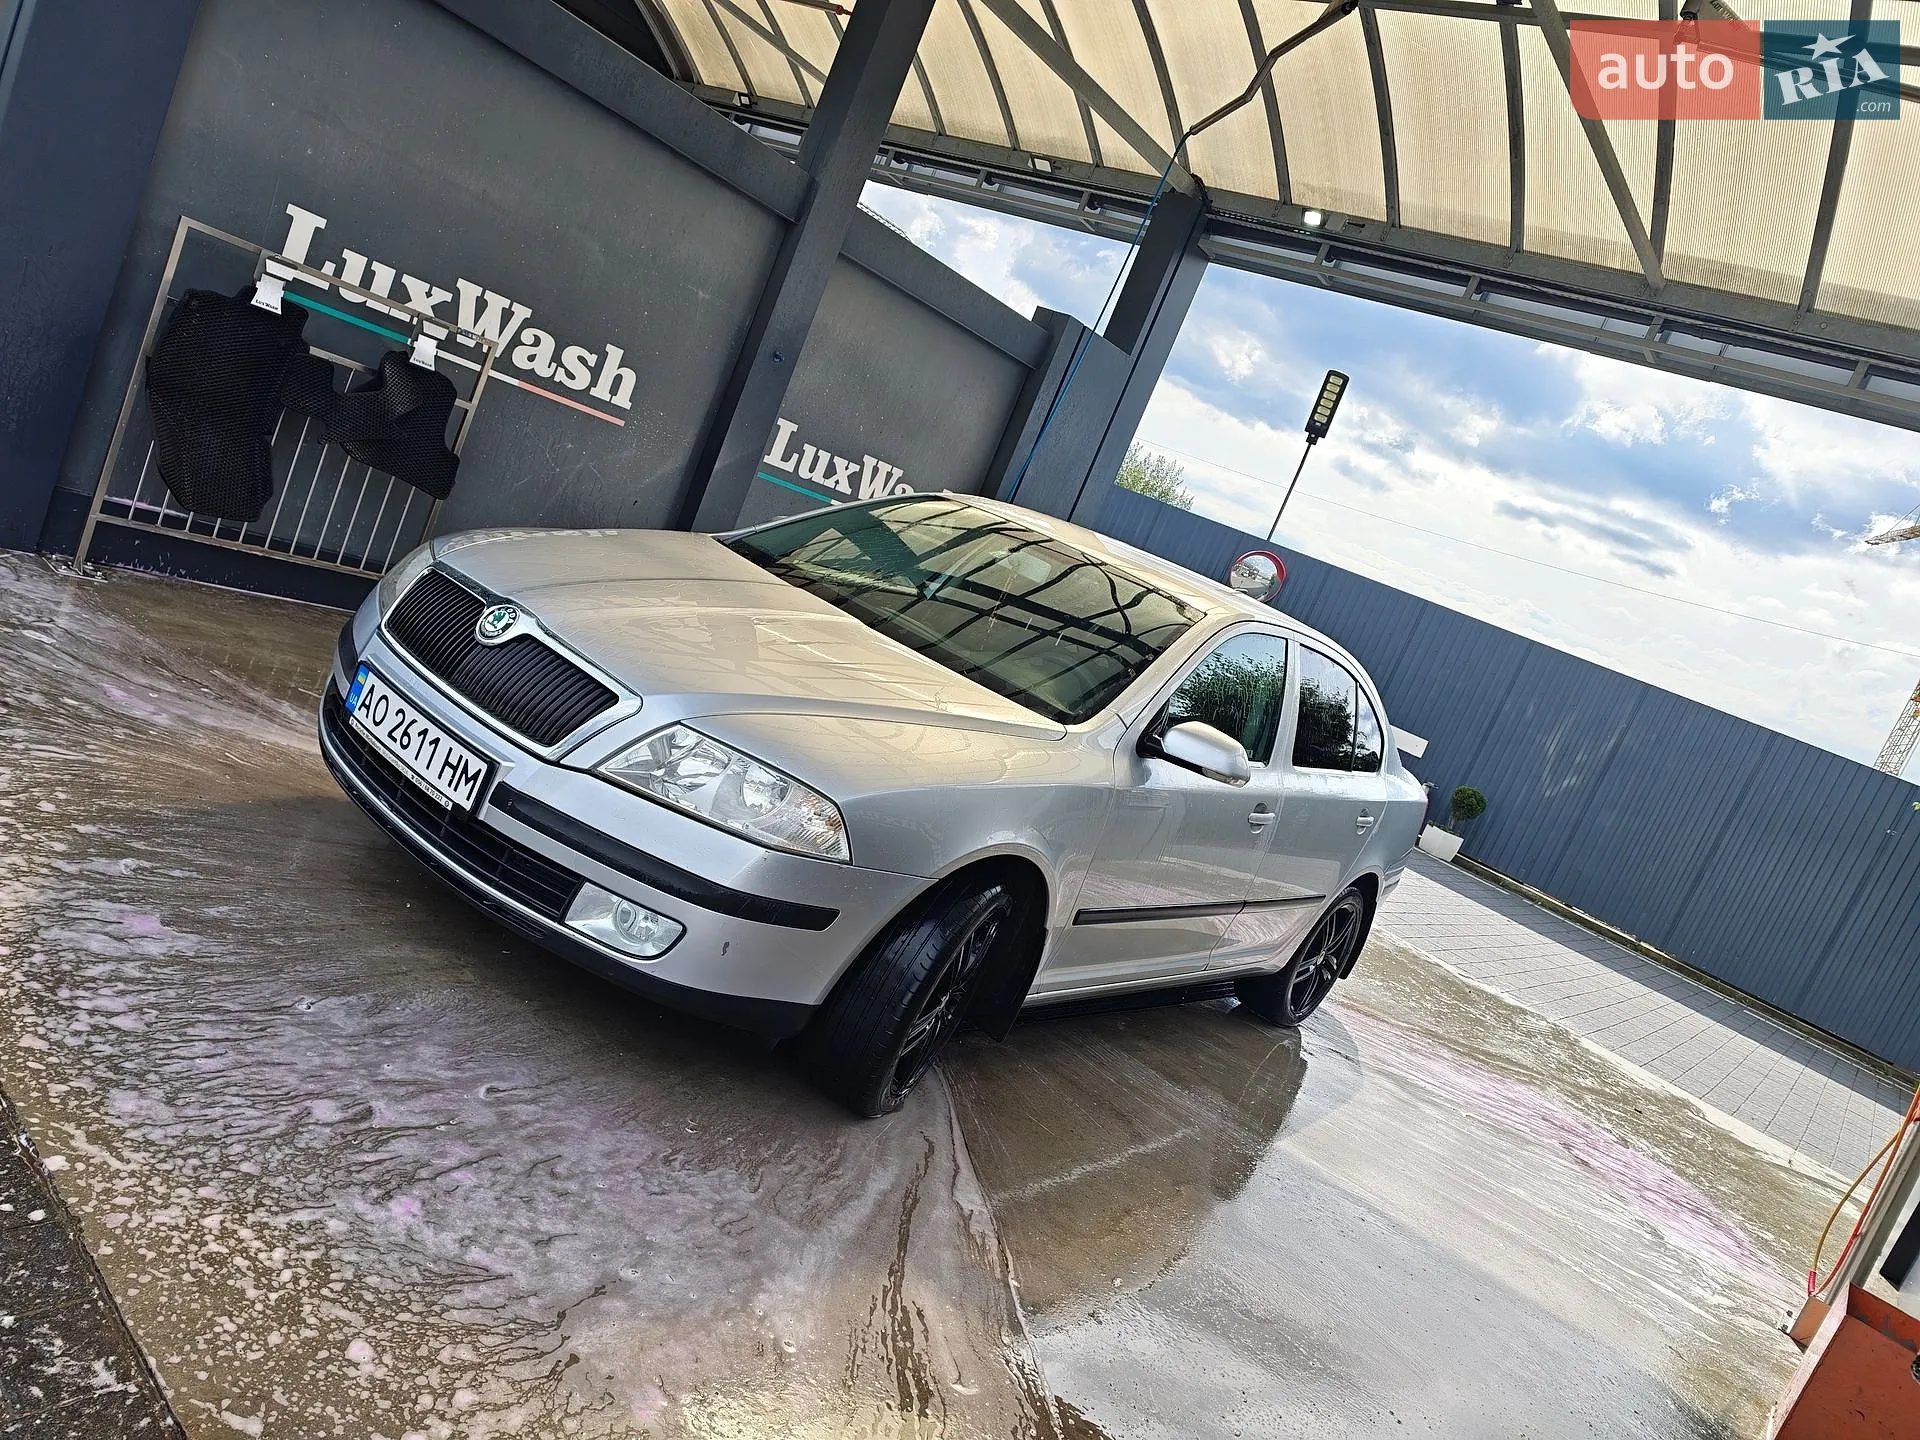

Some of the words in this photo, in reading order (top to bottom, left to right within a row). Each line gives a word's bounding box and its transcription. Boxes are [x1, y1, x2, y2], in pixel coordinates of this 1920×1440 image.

[266, 203, 639, 410] LuxWash
[763, 417, 953, 500] LuxW
[357, 683, 389, 727] AO
[386, 707, 441, 771] 2611
[437, 746, 483, 802] HM
